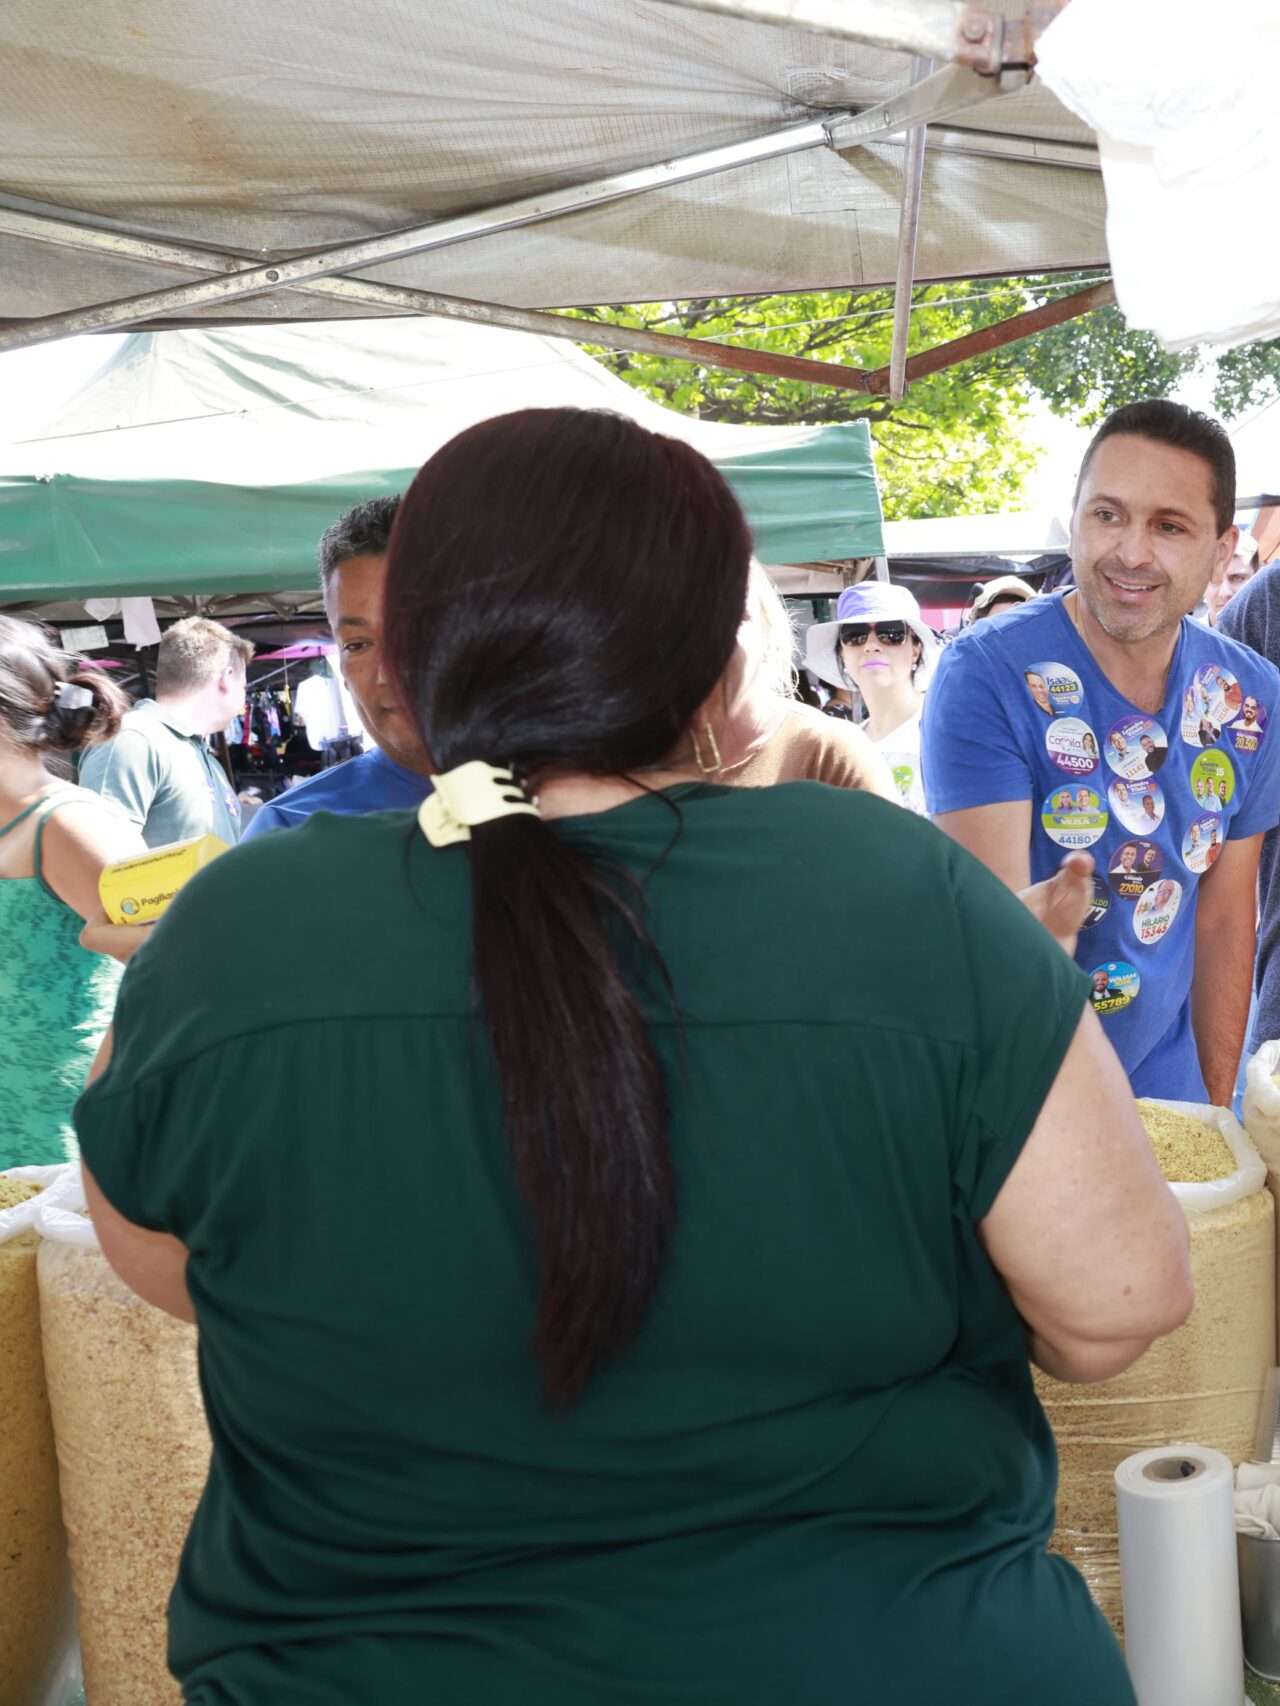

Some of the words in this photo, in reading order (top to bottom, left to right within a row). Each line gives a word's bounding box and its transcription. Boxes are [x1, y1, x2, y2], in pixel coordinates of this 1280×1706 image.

[1050, 683, 1077, 693] 44123
[1048, 735, 1082, 748] Camila
[1057, 754, 1095, 769] 44500
[1059, 836, 1091, 844] 44180
[1119, 883, 1145, 894] 27010
[1093, 995, 1130, 1010] 55789
